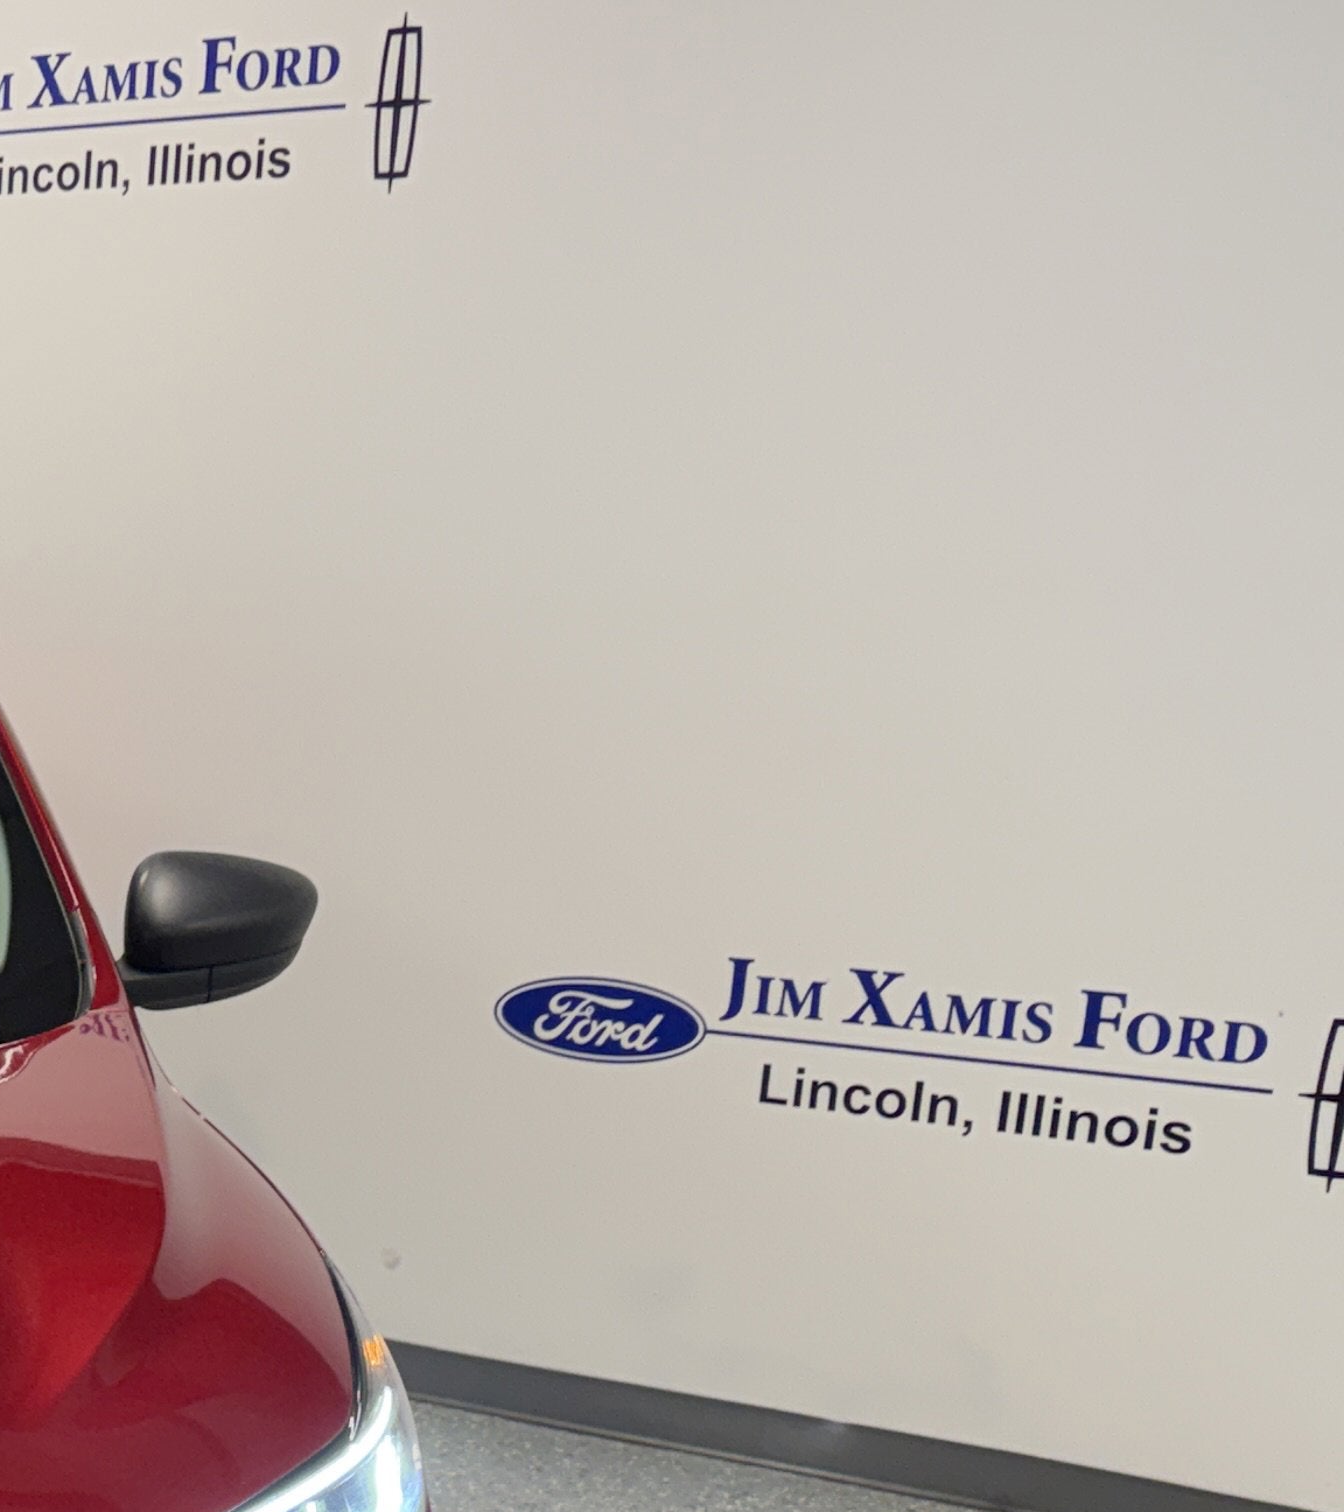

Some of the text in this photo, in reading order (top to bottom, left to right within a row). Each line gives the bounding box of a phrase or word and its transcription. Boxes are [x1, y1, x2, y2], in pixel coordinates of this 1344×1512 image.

[26, 52, 183, 109] XAMIS
[198, 35, 341, 95] FORD
[147, 137, 291, 187] Illinois
[532, 990, 658, 1052] Ford
[718, 956, 1269, 1064] JIM XAMIS FORD
[758, 1063, 1193, 1155] Lincoln, Illinois
